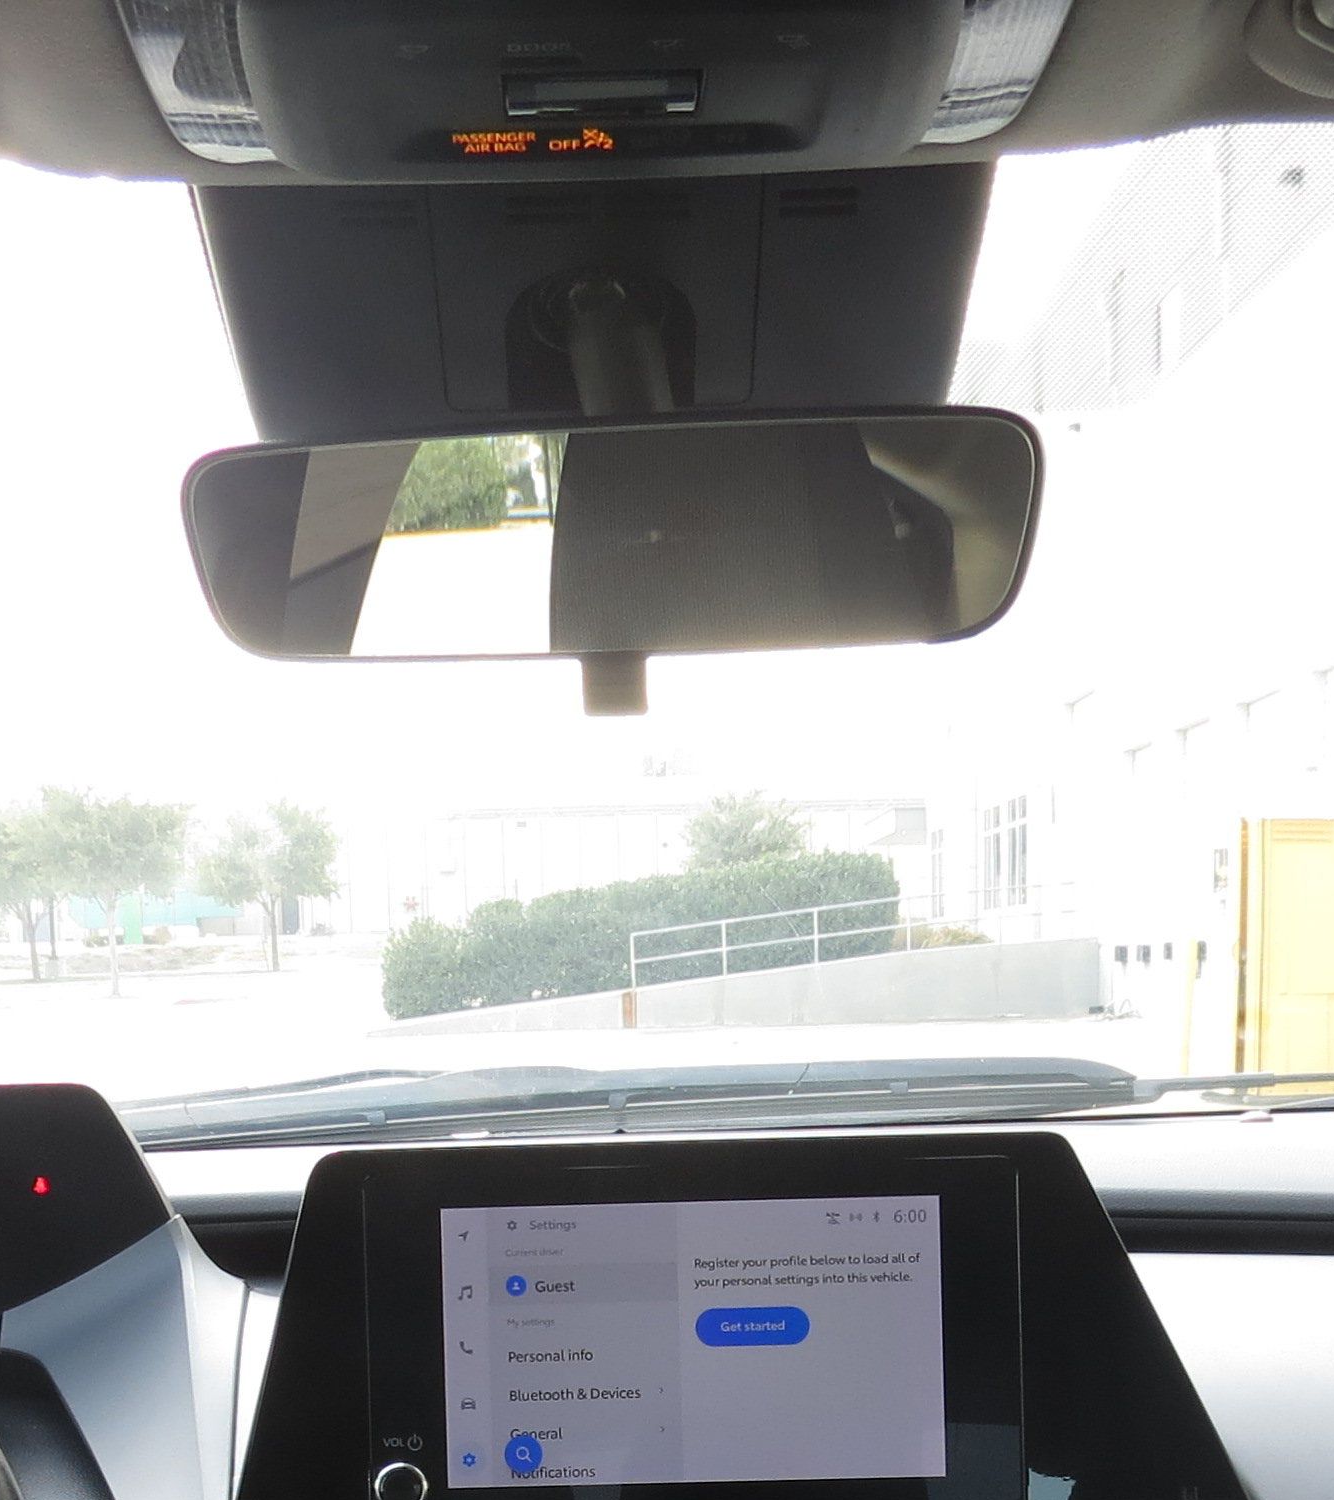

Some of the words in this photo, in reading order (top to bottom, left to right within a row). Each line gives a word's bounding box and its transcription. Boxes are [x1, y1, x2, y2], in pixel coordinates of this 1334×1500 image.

[451, 131, 536, 144] PASSENGER
[463, 142, 491, 154] AIR
[494, 140, 528, 153] BAG
[548, 140, 581, 151] OFF
[893, 1209, 927, 1223] 6:00
[529, 1218, 577, 1232] Settings
[694, 1258, 739, 1270] Register
[742, 1259, 767, 1270] your
[770, 1256, 807, 1268] profile
[810, 1255, 846, 1266] below
[848, 1256, 860, 1265] to
[863, 1254, 889, 1264] load
[891, 1254, 906, 1264] all
[908, 1253, 921, 1264] of
[535, 1280, 576, 1294] Guest
[694, 1278, 720, 1290] your
[722, 1276, 772, 1288] personal
[775, 1274, 820, 1286] settings
[823, 1274, 845, 1284] into
[847, 1272, 868, 1283] this
[871, 1272, 913, 1282] vehicle.
[521, 1318, 555, 1328] settings
[720, 1322, 742, 1332] Get
[744, 1320, 786, 1332] started
[508, 1350, 565, 1363] Personal
[568, 1349, 594, 1362] info
[509, 1388, 575, 1402] Bluetooth
[577, 1388, 587, 1400] &
[590, 1387, 641, 1400] Devices
[510, 1428, 563, 1440] General
[383, 1438, 405, 1448] VOL
